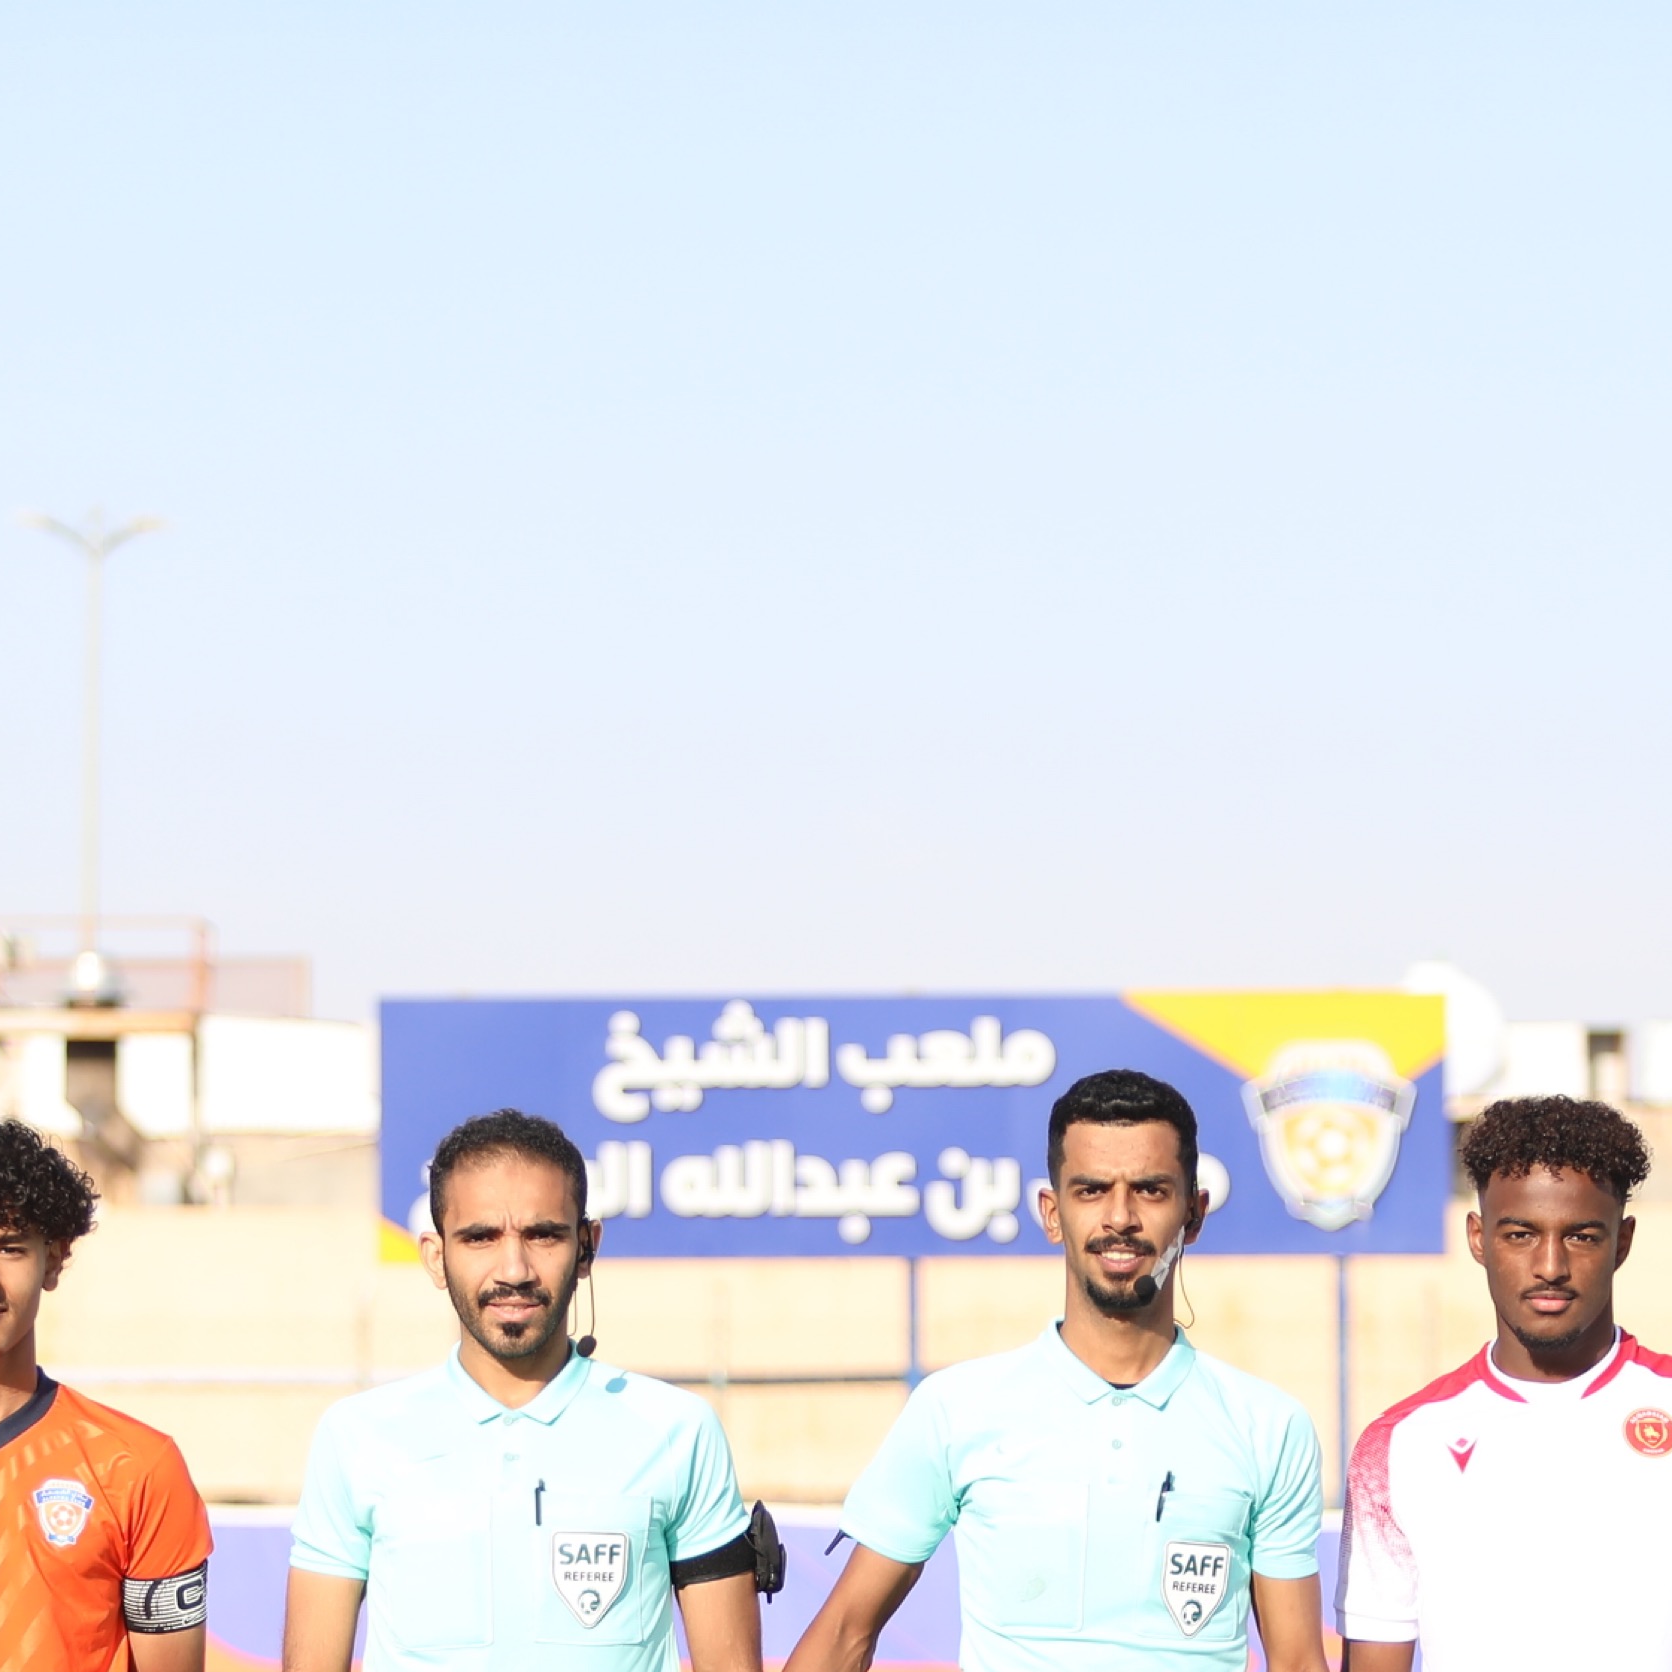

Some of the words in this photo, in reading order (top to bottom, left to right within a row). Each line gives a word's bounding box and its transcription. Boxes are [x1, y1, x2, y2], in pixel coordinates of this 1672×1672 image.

[591, 998, 830, 1124] الشيخ
[836, 1014, 1058, 1115] ملعب
[660, 1138, 920, 1245] عبدالله
[923, 1146, 1022, 1241] بن
[558, 1543, 622, 1565] SAFF
[1170, 1553, 1225, 1578] SAFF
[564, 1571, 615, 1582] REFEREE
[1172, 1581, 1216, 1594] REFEREE
[176, 1577, 204, 1610] C
